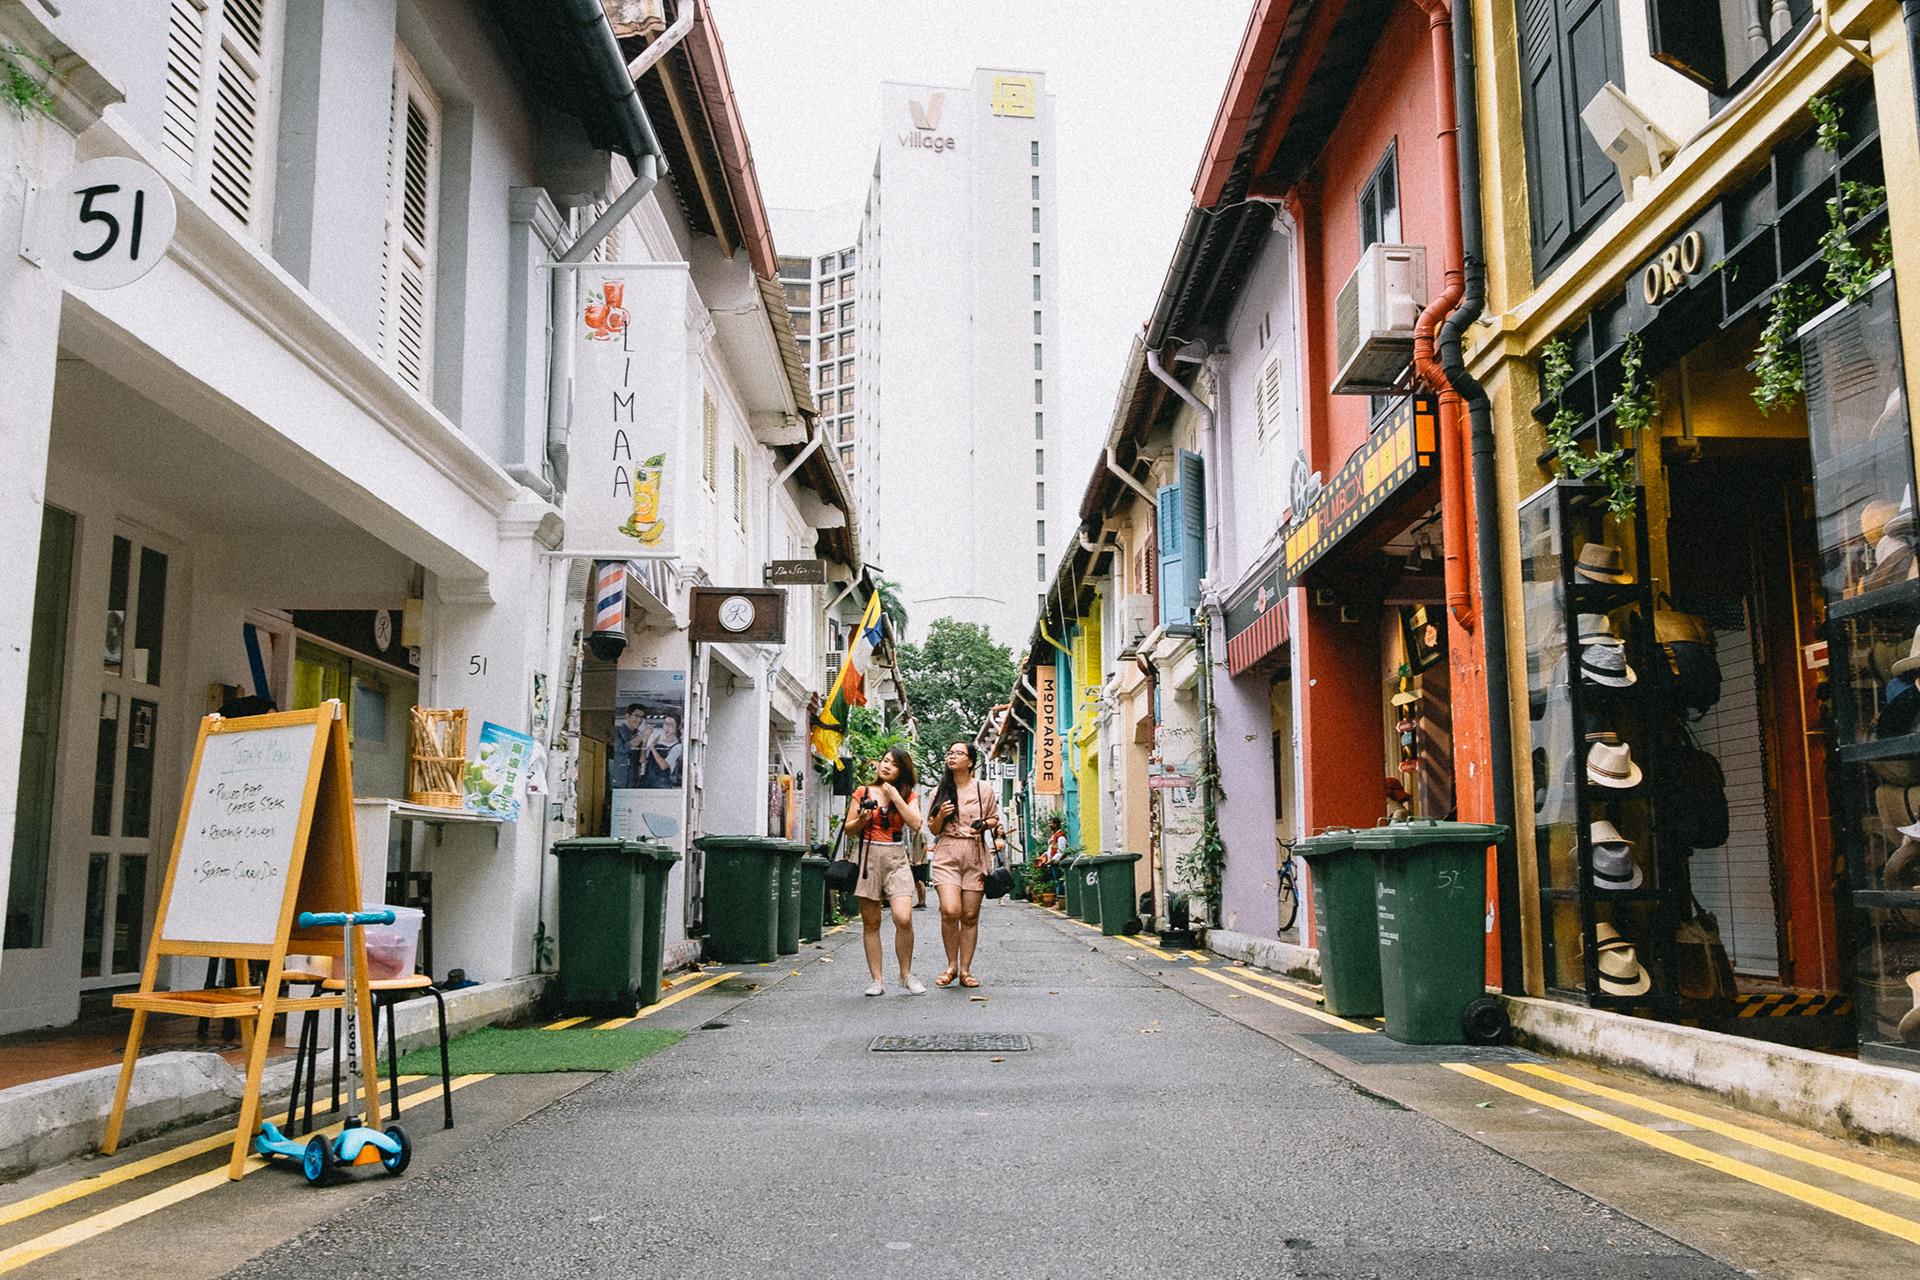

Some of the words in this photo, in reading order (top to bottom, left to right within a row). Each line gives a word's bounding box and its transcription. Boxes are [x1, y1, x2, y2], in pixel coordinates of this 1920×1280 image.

[899, 132, 955, 153] village
[73, 184, 145, 262] 51
[1643, 230, 1704, 306] ORO
[613, 320, 635, 498] LIMAA
[1317, 470, 1365, 535] FILMBOX
[469, 655, 488, 676] 51
[642, 656, 658, 668] 53
[1043, 679, 1054, 781] MODPARADE
